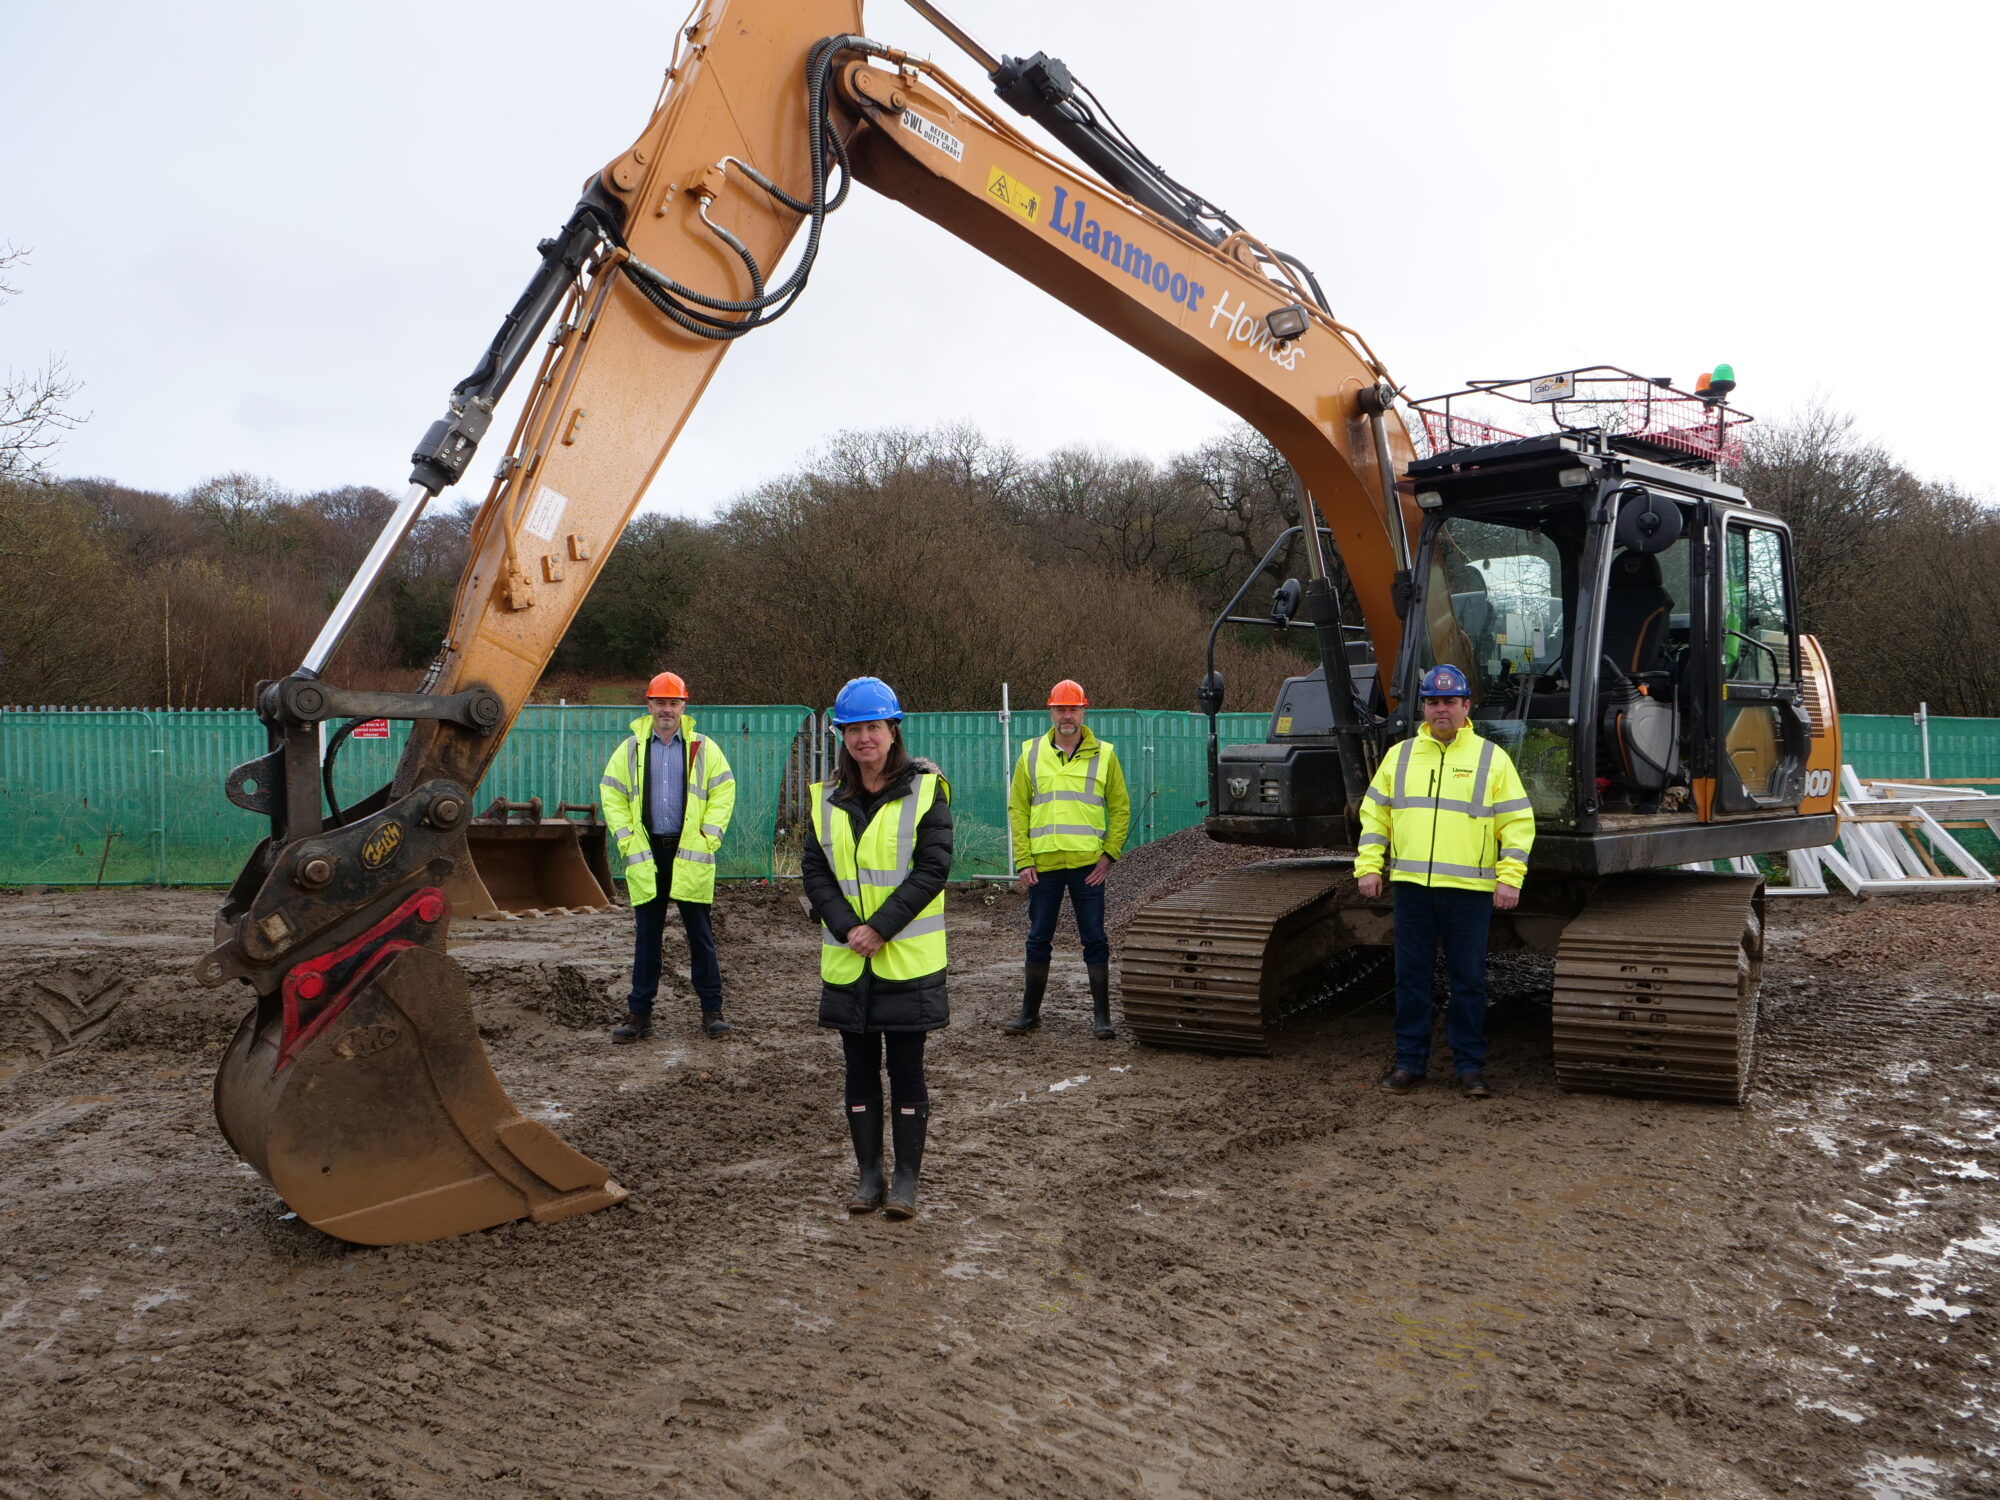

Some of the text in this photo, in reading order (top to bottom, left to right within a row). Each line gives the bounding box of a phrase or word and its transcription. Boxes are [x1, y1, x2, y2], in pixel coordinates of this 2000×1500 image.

[903, 110, 923, 134] SWL
[924, 130, 961, 159] DUTY CHART
[930, 125, 959, 149] REFER TO
[1048, 185, 1205, 313] Llanmoor
